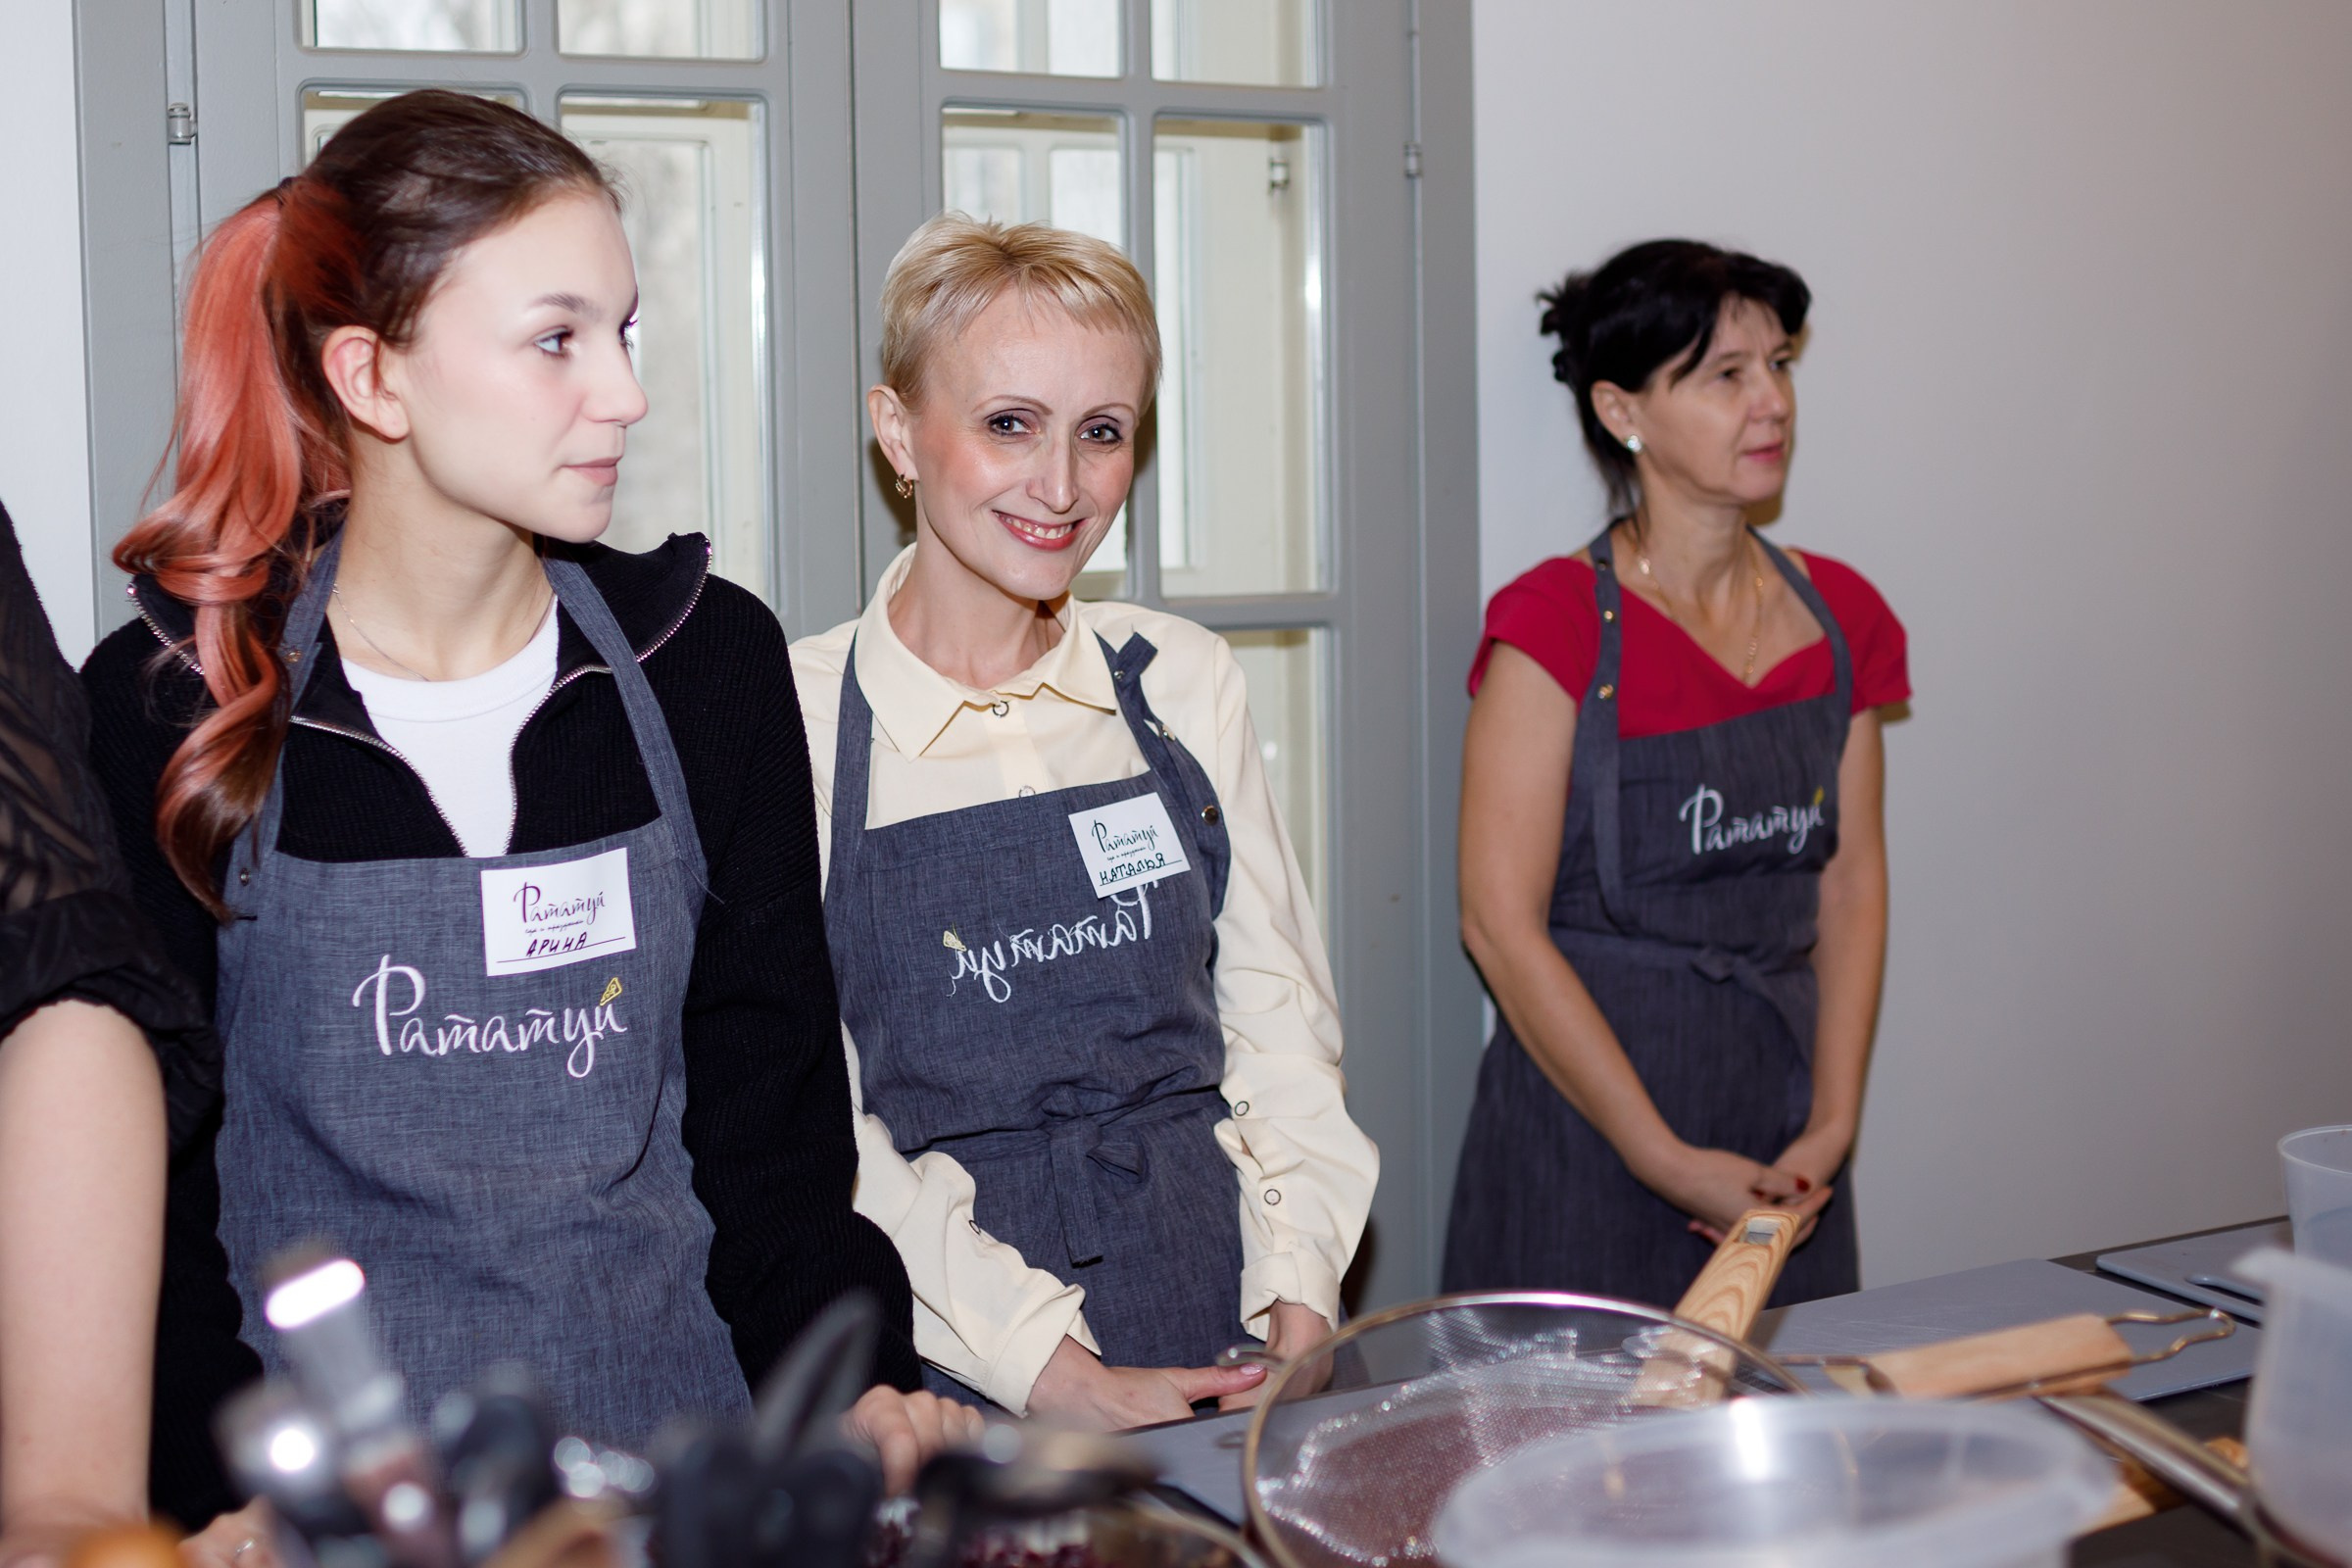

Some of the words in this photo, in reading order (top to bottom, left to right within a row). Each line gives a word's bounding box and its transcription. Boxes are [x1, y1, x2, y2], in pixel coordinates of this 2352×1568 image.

[1100, 852, 1166, 885] НАТАЛЬЯ
[513, 881, 606, 925] Рататуй
[526, 931, 588, 957] АРИНА
[352, 954, 628, 1078] Рататуй
